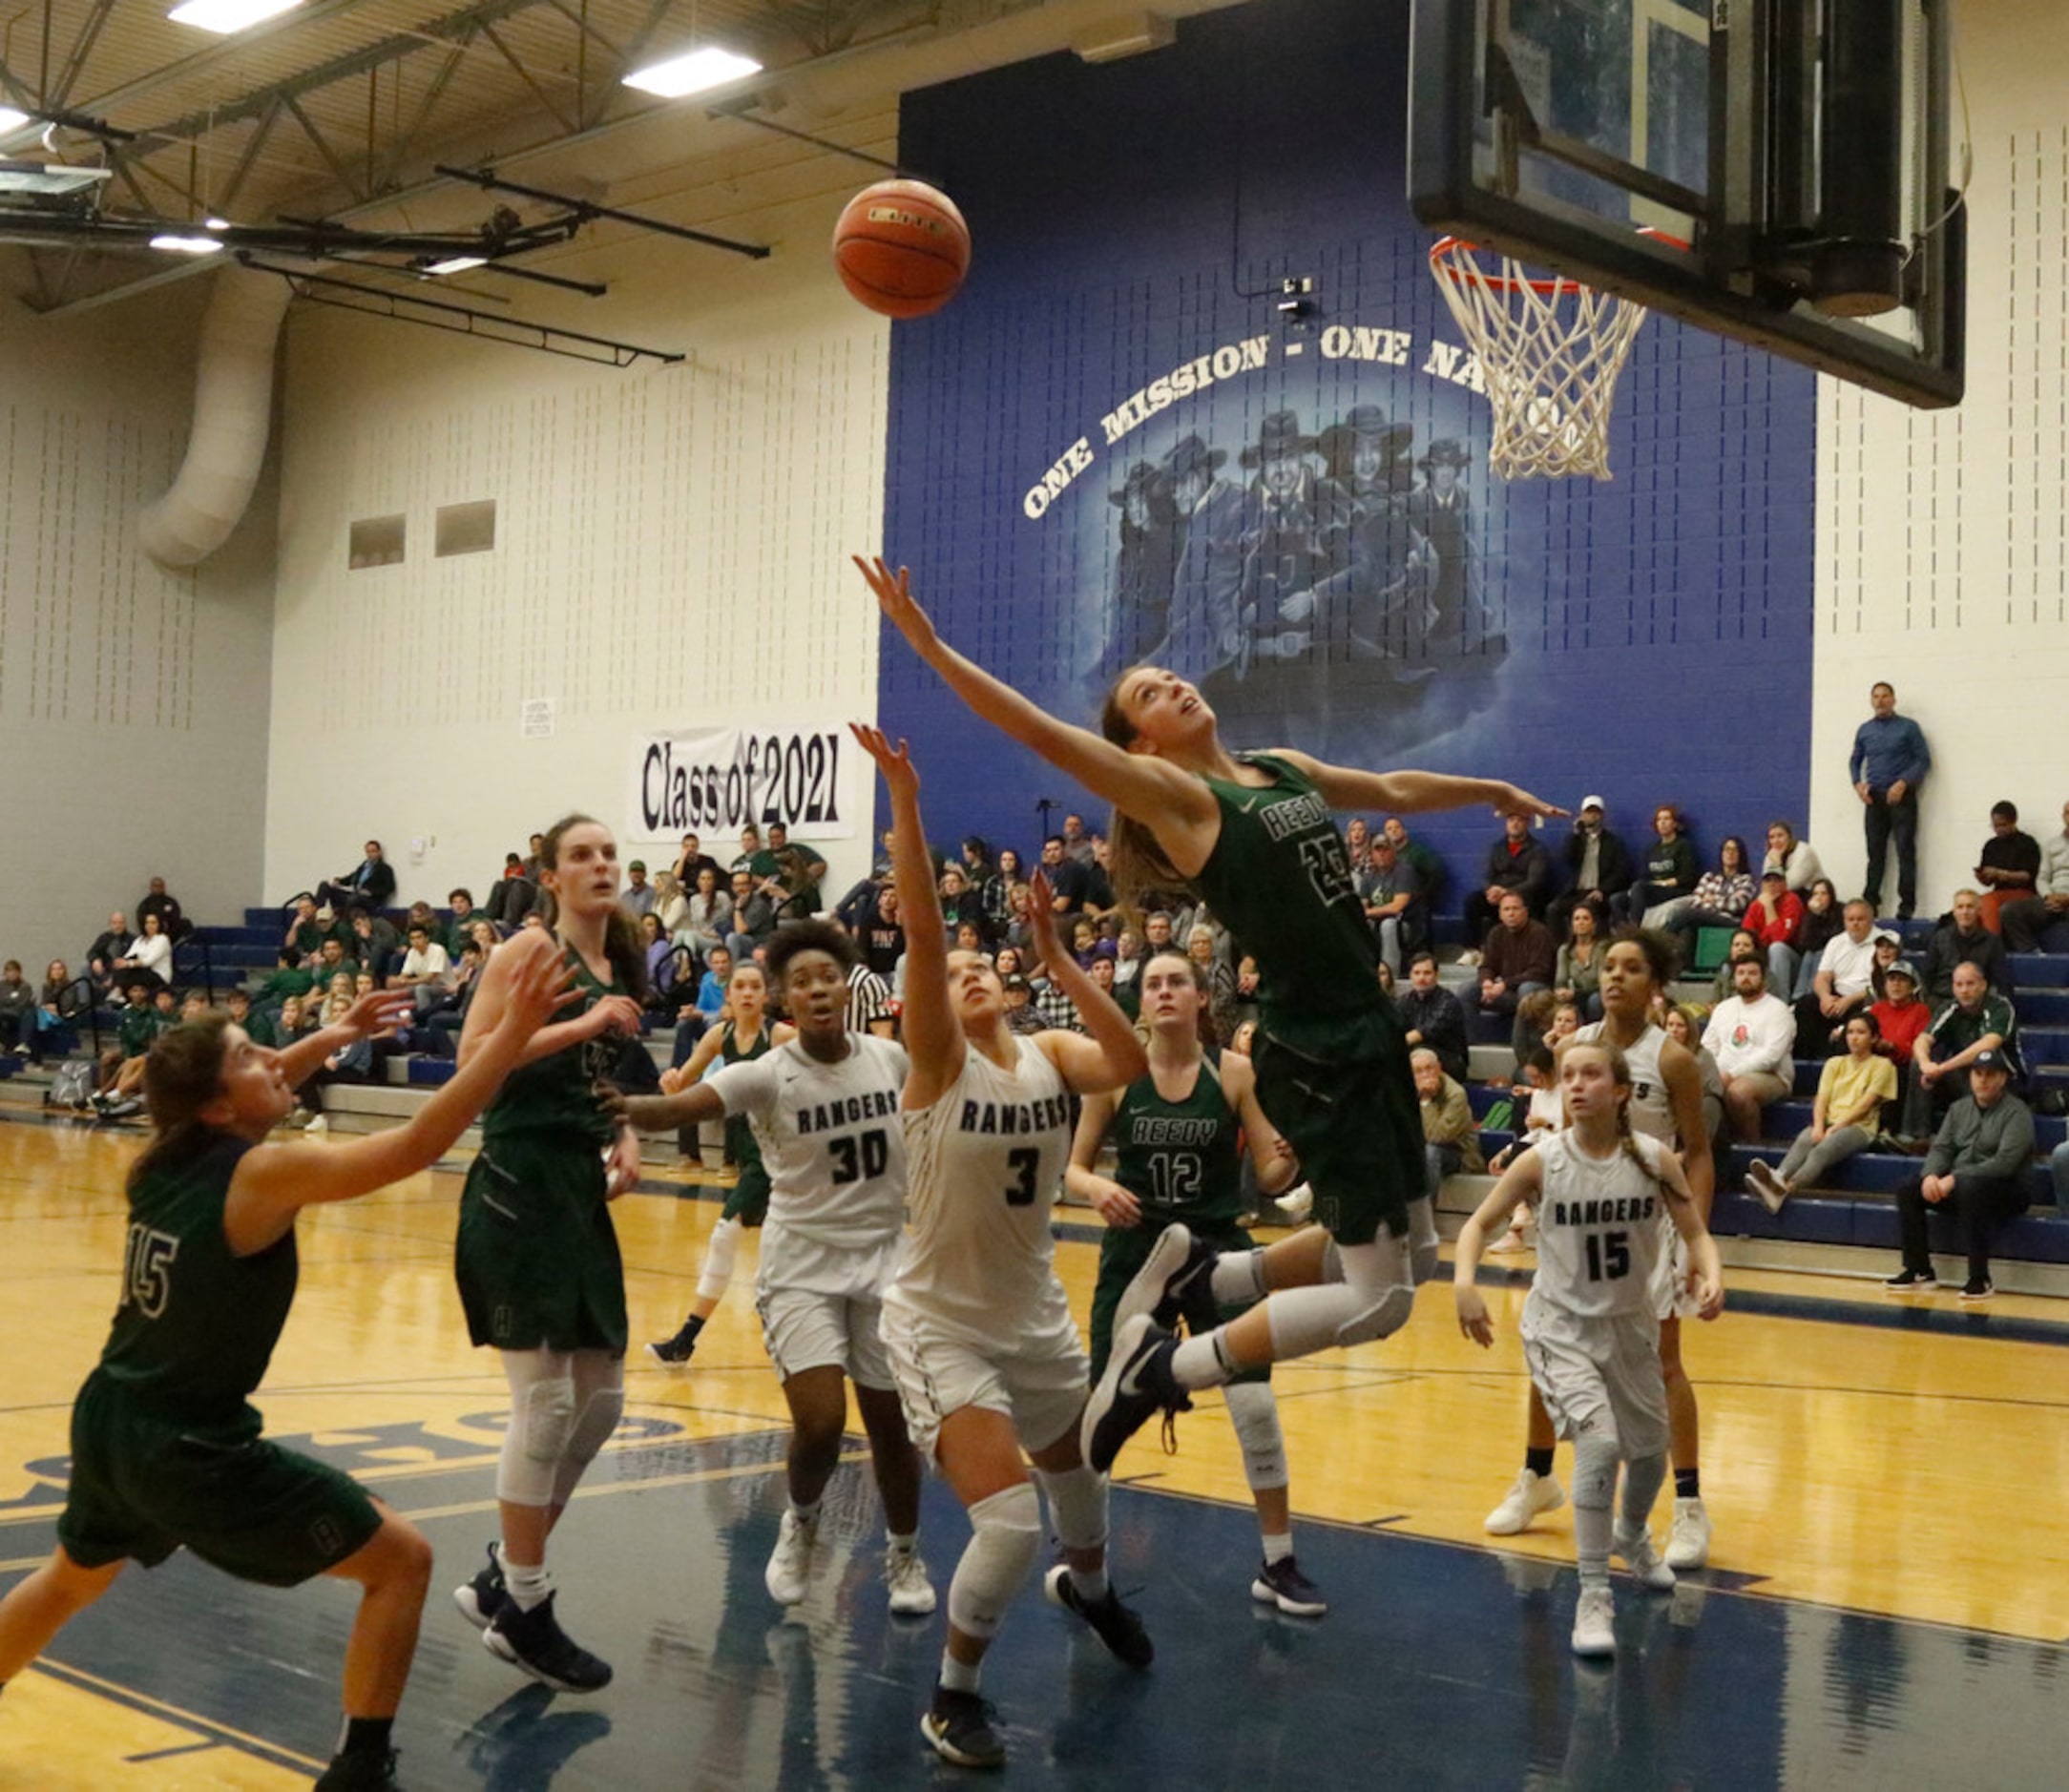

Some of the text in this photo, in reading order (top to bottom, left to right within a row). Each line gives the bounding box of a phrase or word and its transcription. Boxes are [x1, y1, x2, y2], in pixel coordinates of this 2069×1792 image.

[1023, 435, 1096, 520] ONE
[1100, 335, 1270, 446] MISSION
[1320, 324, 1412, 366] ONE
[642, 732, 840, 833] Class of 2021
[797, 1089, 897, 1135] RANGERS
[959, 1093, 1067, 1136] RANGERS
[1132, 1115, 1218, 1146] REEDY
[827, 1128, 888, 1186] 30
[1005, 1147, 1040, 1207] 3
[1147, 1152, 1202, 1203] 12
[1555, 1195, 1656, 1226] RANGERS
[121, 1221, 180, 1319] 15
[1585, 1231, 1631, 1282] 15
